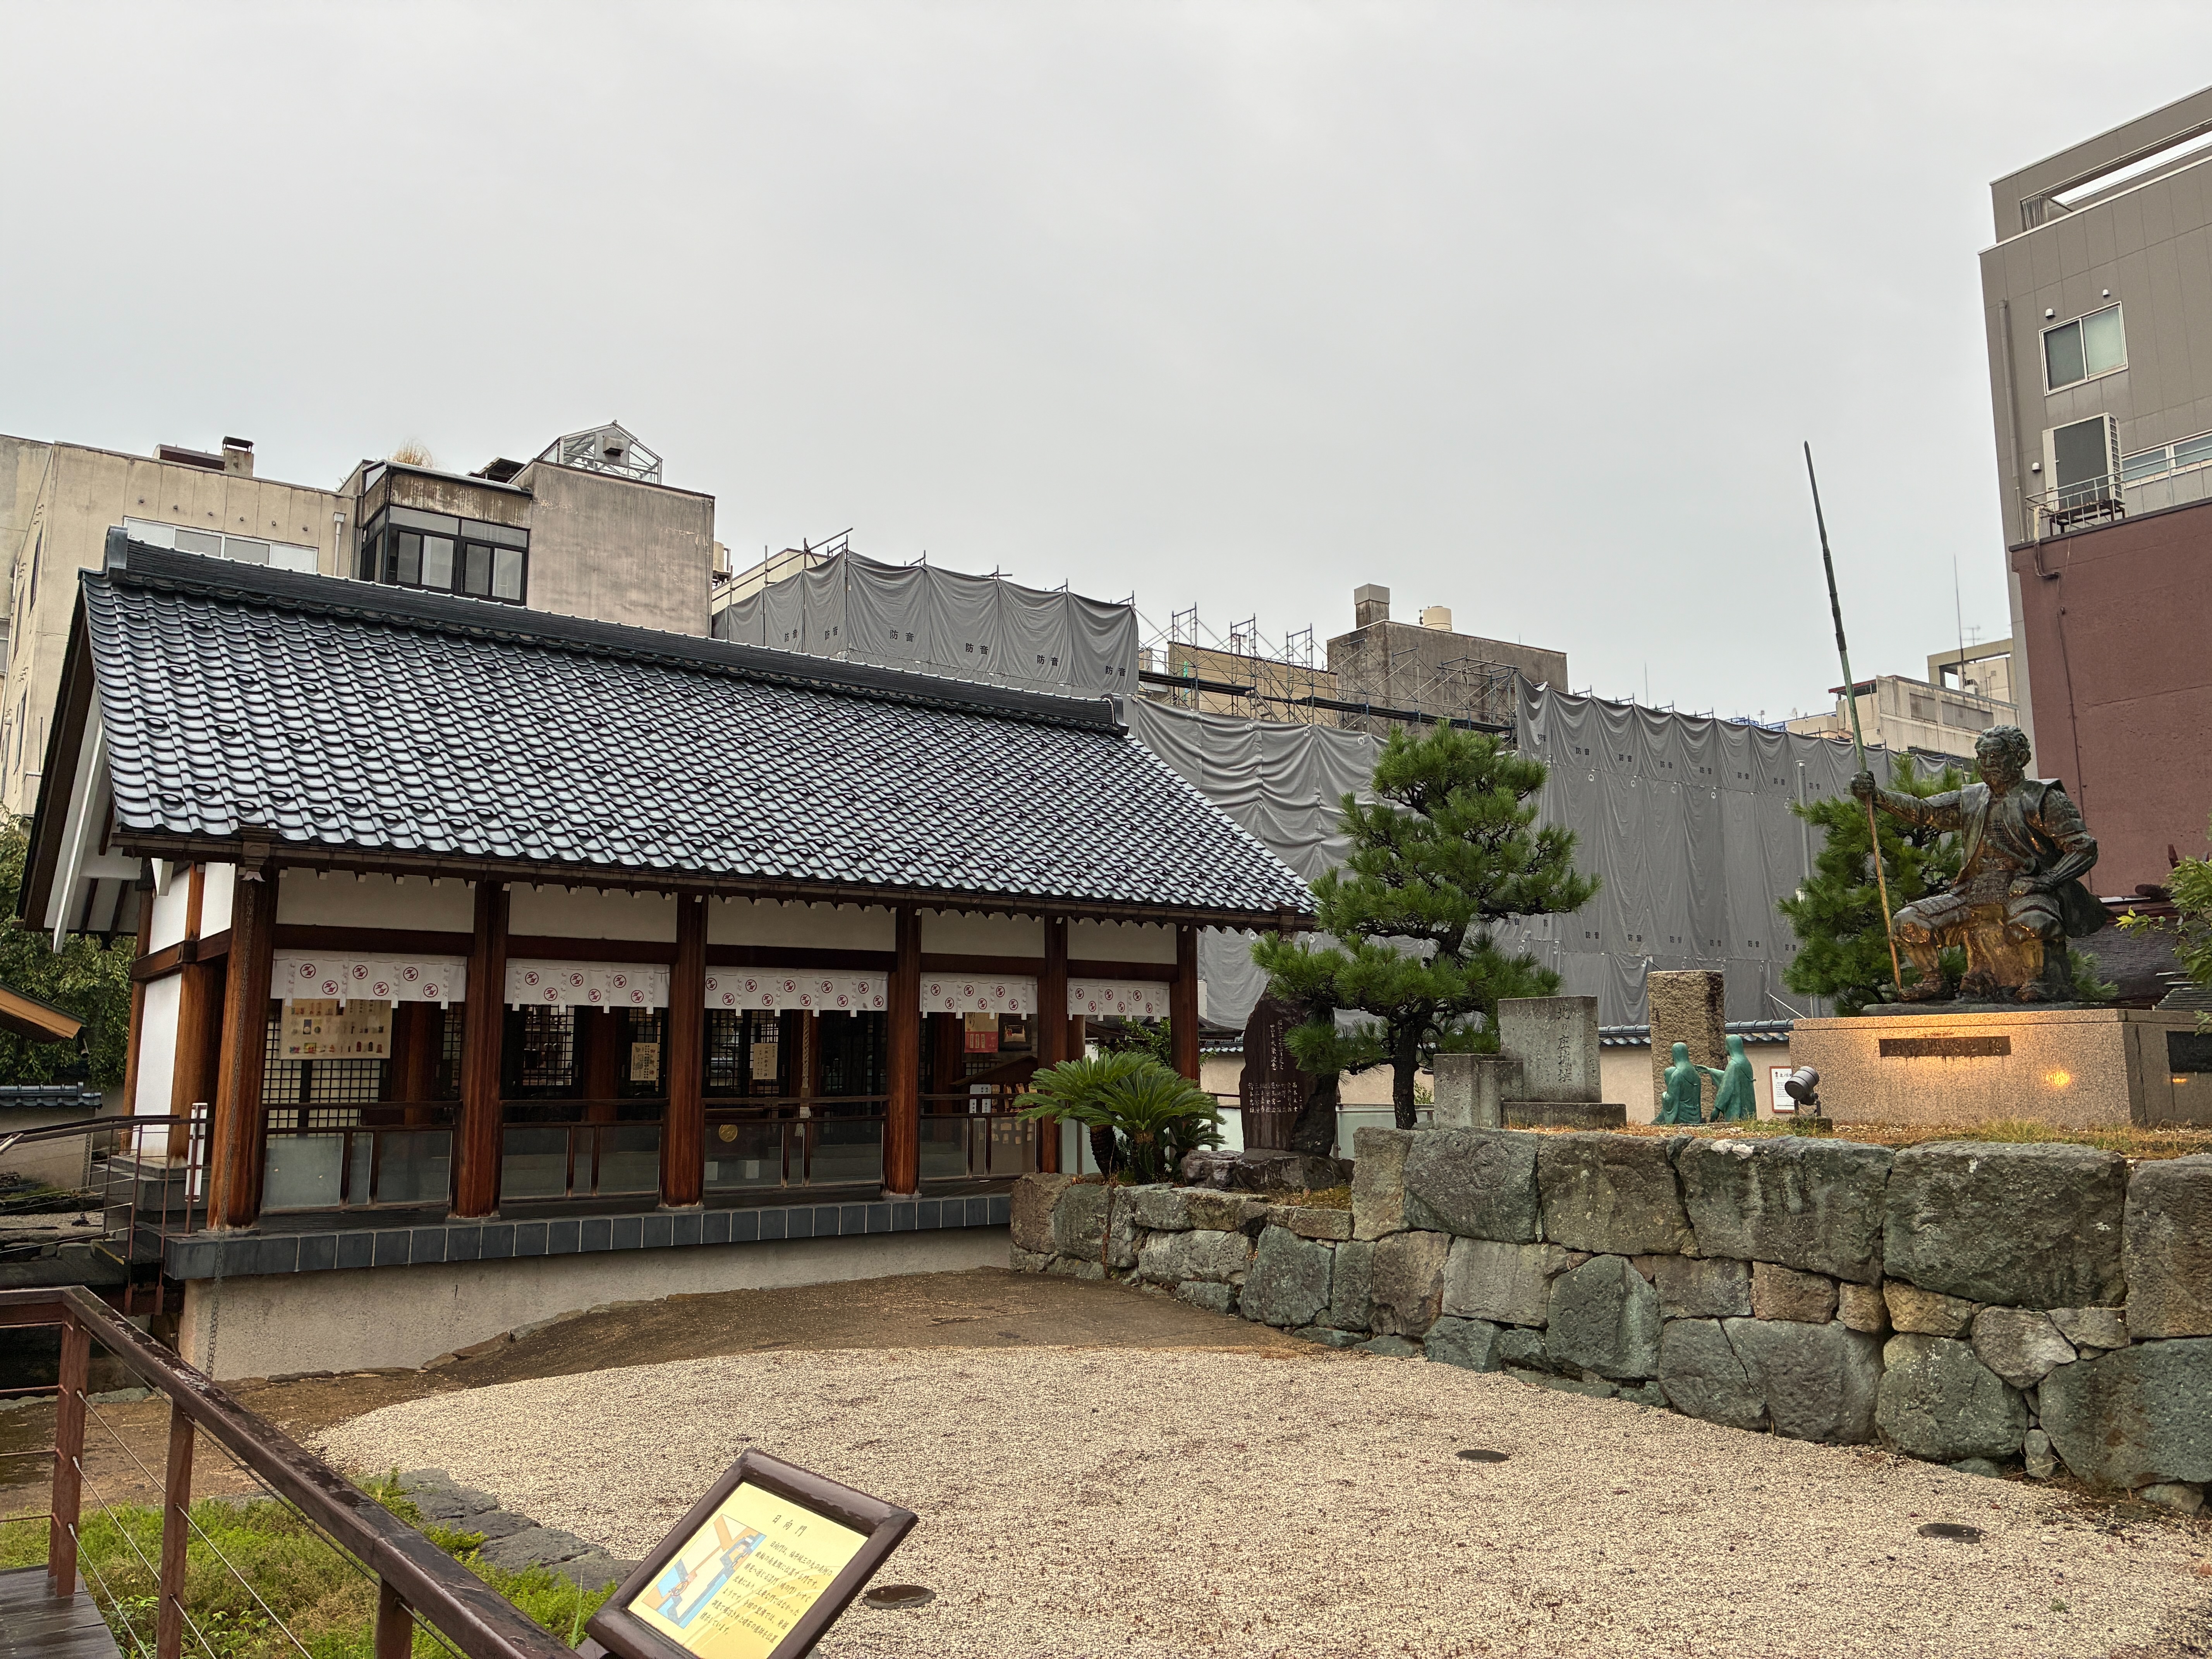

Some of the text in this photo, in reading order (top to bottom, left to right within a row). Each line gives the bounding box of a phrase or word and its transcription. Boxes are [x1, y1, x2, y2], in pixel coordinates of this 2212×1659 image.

[785, 629, 798, 642] 防音
[825, 626, 838, 640] 防音
[890, 630, 914, 642] 防音
[965, 643, 988, 655] 防音
[1037, 655, 1058, 666] 防音
[1106, 666, 1126, 677] 防音
[1576, 747, 1589, 756] 防音
[1619, 754, 1632, 762] 防音
[1660, 761, 1673, 769] 防音
[1628, 934, 1642, 942] 防音
[772, 1515, 807, 1537] 日向門
